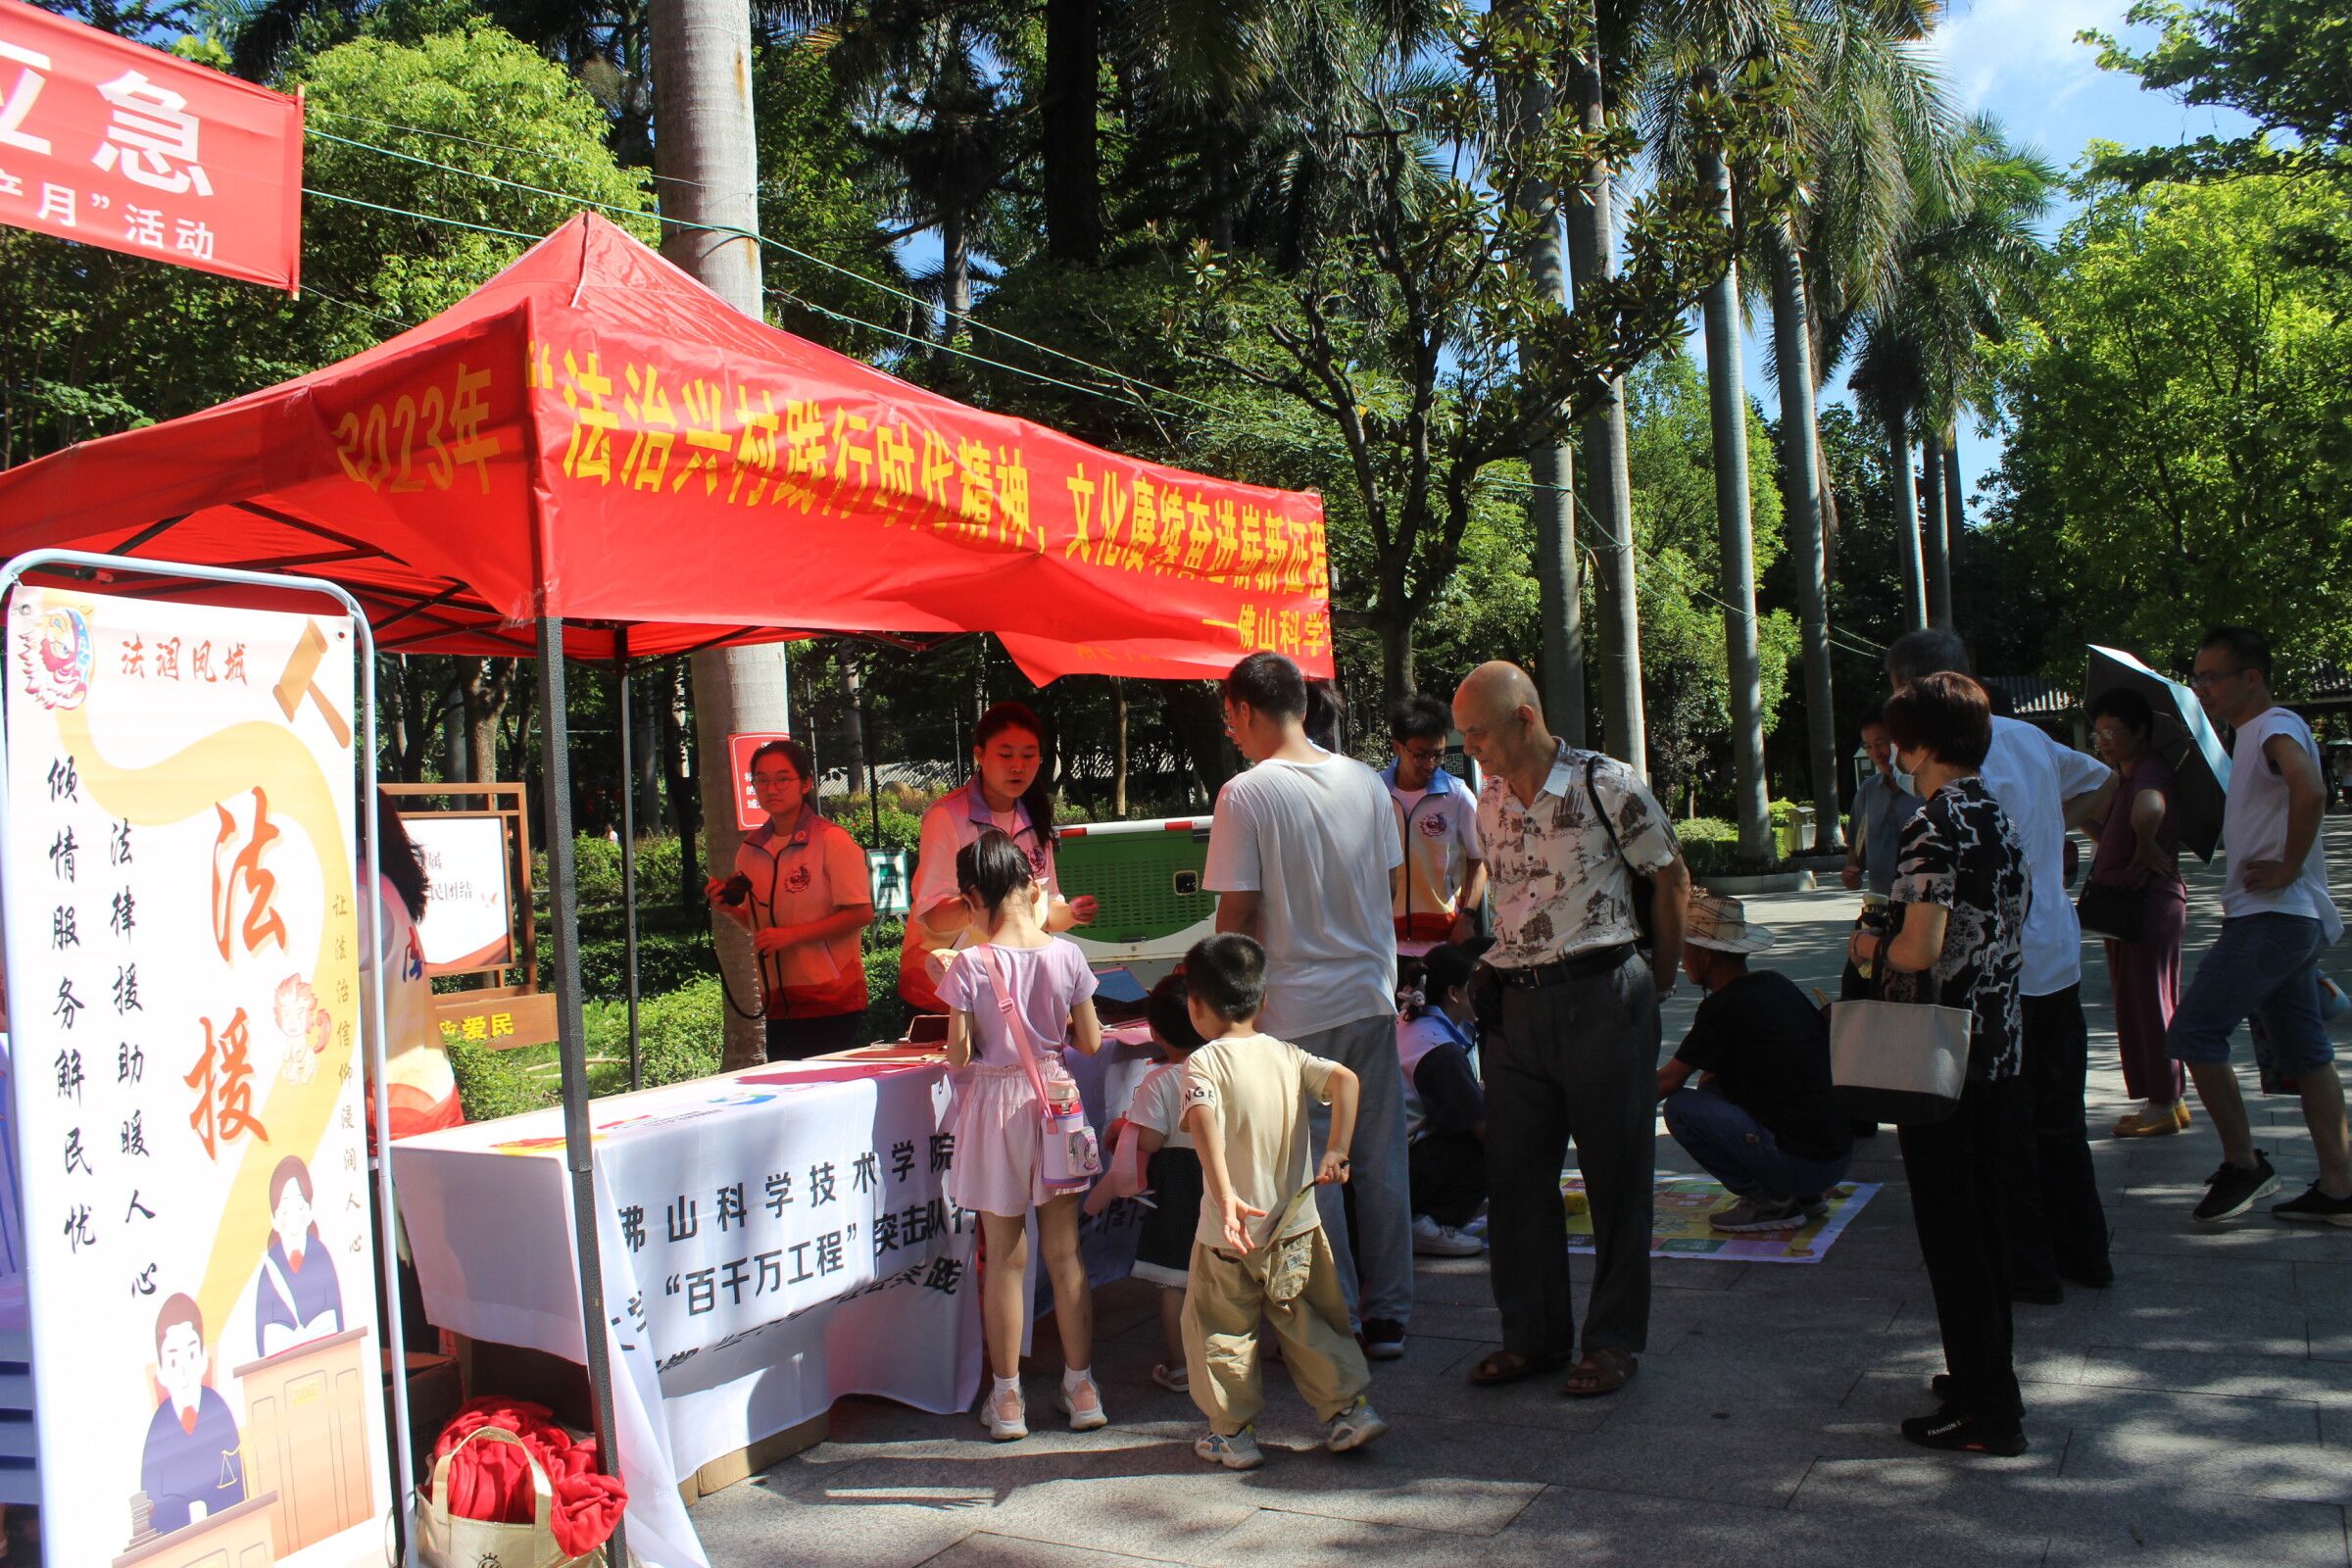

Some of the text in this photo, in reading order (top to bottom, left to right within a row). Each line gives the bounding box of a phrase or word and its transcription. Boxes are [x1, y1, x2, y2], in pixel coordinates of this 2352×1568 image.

[332, 362, 501, 495] 2023年
[110, 817, 157, 1298] 法律援助暖人心
[183, 786, 288, 1160] 法援
[617, 1132, 956, 1253] 佛山科学技术学院
